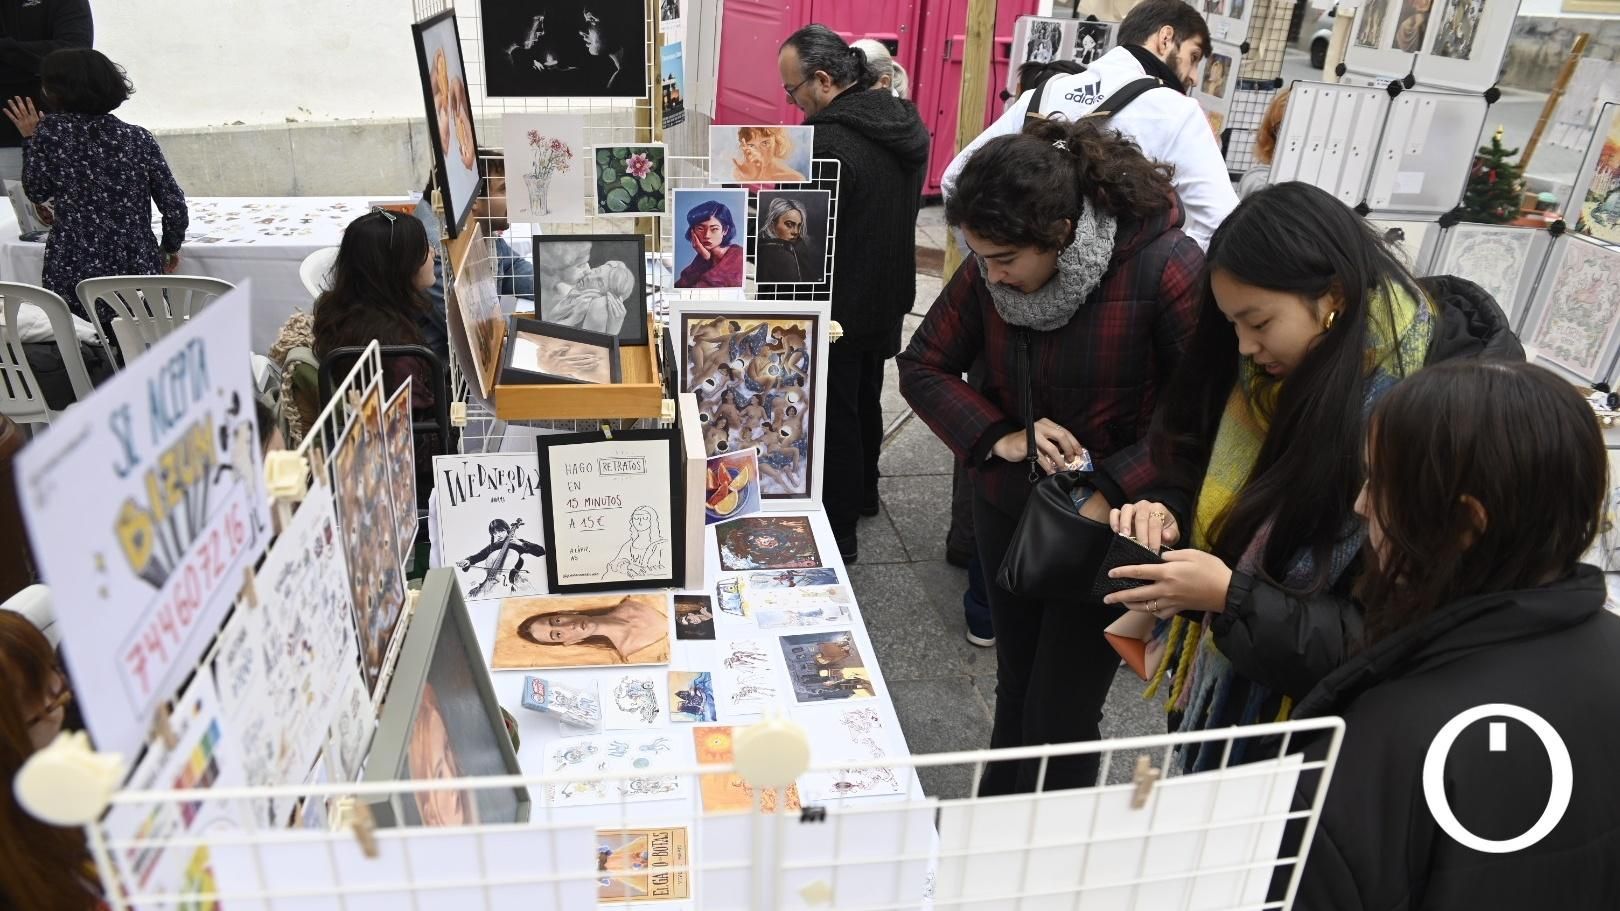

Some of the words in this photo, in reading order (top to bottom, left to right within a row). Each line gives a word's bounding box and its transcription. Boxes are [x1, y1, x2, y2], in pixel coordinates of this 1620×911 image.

[109, 403, 141, 478] SE
[565, 462, 593, 476] HAGO
[602, 460, 642, 472] RETRATOS
[114, 410, 218, 577] BIZUM
[567, 480, 581, 492] EN
[566, 497, 579, 509] 15
[584, 495, 622, 508] MINUTOS
[569, 517, 575, 529] A
[580, 515, 605, 529] 15€
[651, 831, 669, 856] BOTAS
[652, 861, 669, 885] GAO
